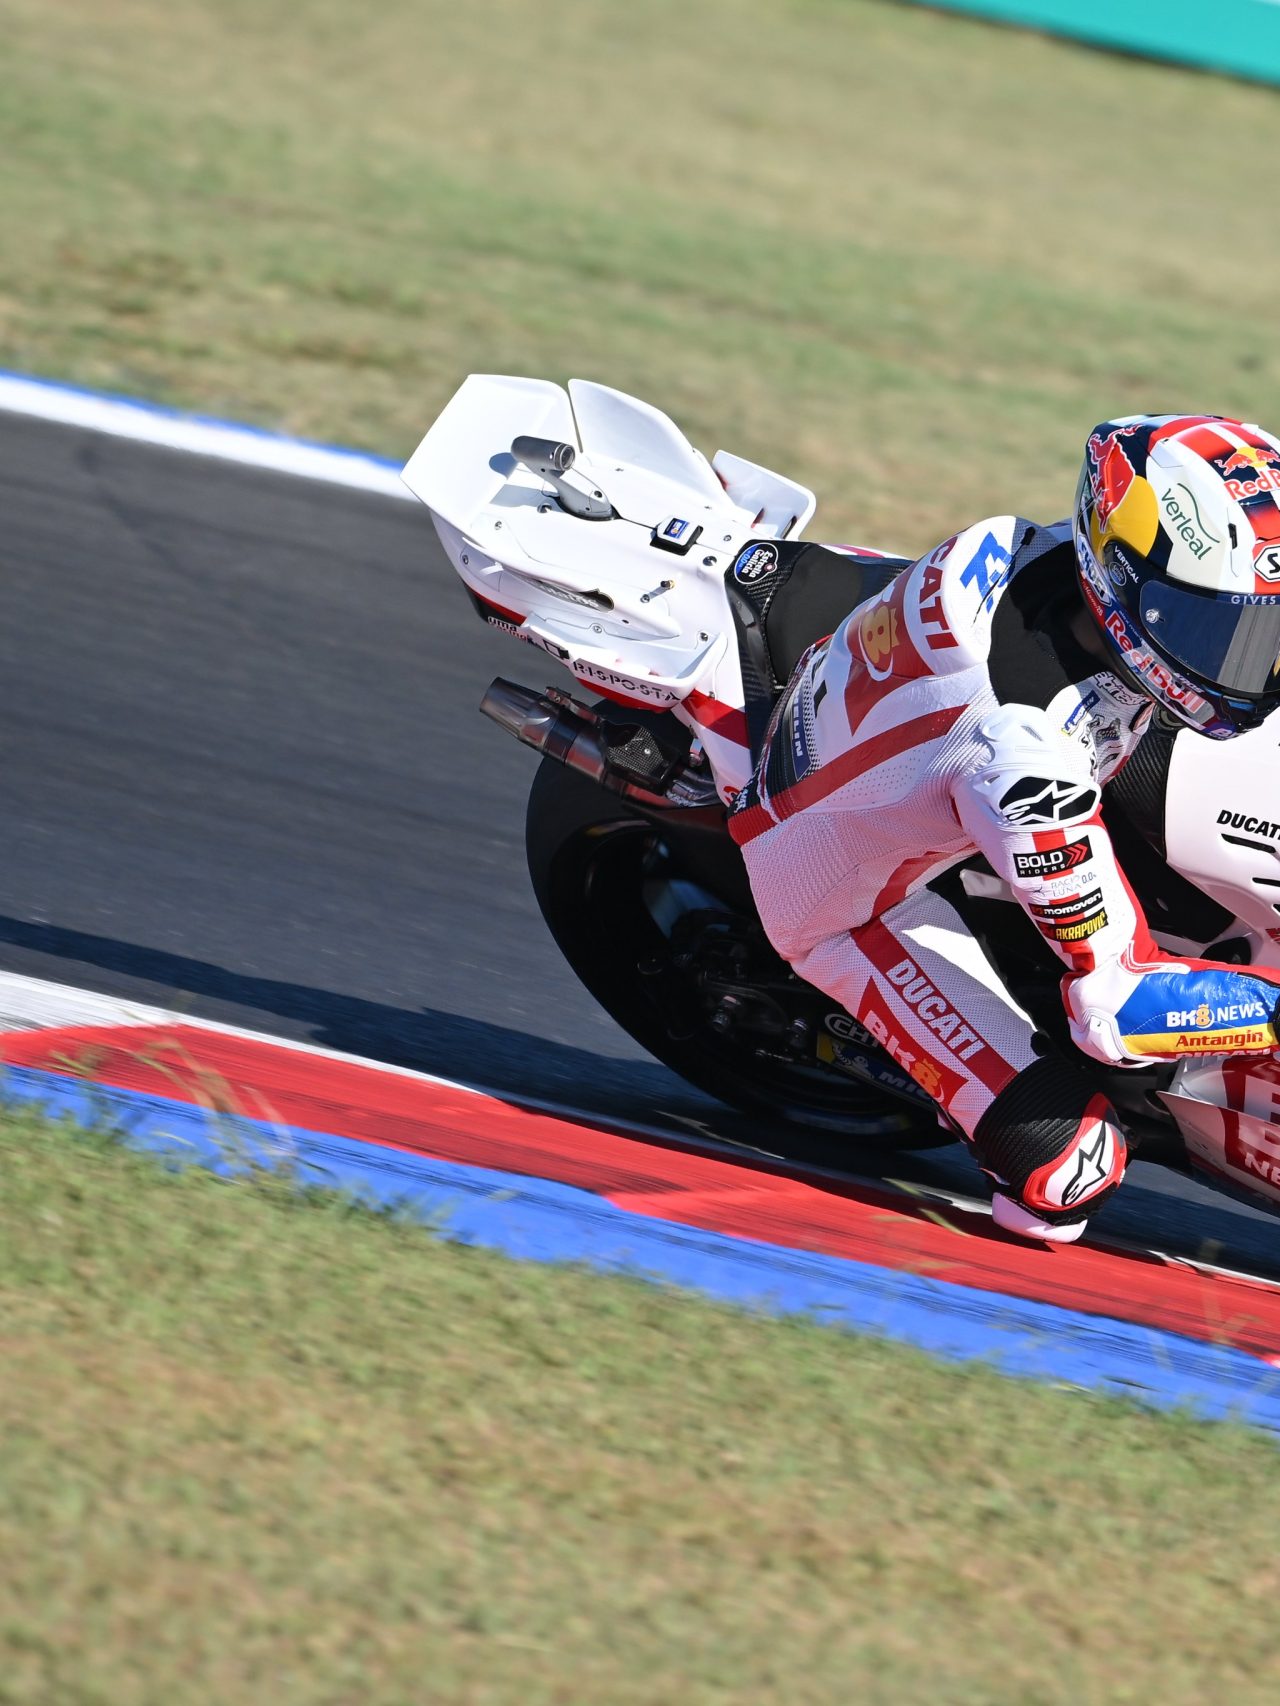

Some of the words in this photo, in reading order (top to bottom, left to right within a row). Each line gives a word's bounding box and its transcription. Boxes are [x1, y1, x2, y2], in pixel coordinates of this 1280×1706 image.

[1224, 471, 1272, 500] Red
[1160, 488, 1212, 560] verleal
[741, 549, 765, 574] Galicia
[749, 551, 774, 578] Estrella
[1114, 545, 1140, 584] VERTICAL
[1231, 594, 1277, 605] GIVES
[1105, 610, 1153, 672] Red
[1146, 663, 1207, 714] Bull
[1017, 851, 1064, 868] BOLD
[1019, 863, 1066, 875] RIDERS
[1044, 893, 1102, 915] momoven
[885, 959, 986, 1061] DUCATI
[1166, 1004, 1214, 1028] BK8
[1217, 1001, 1266, 1022] NEWS
[1176, 1030, 1263, 1047] Antangin
